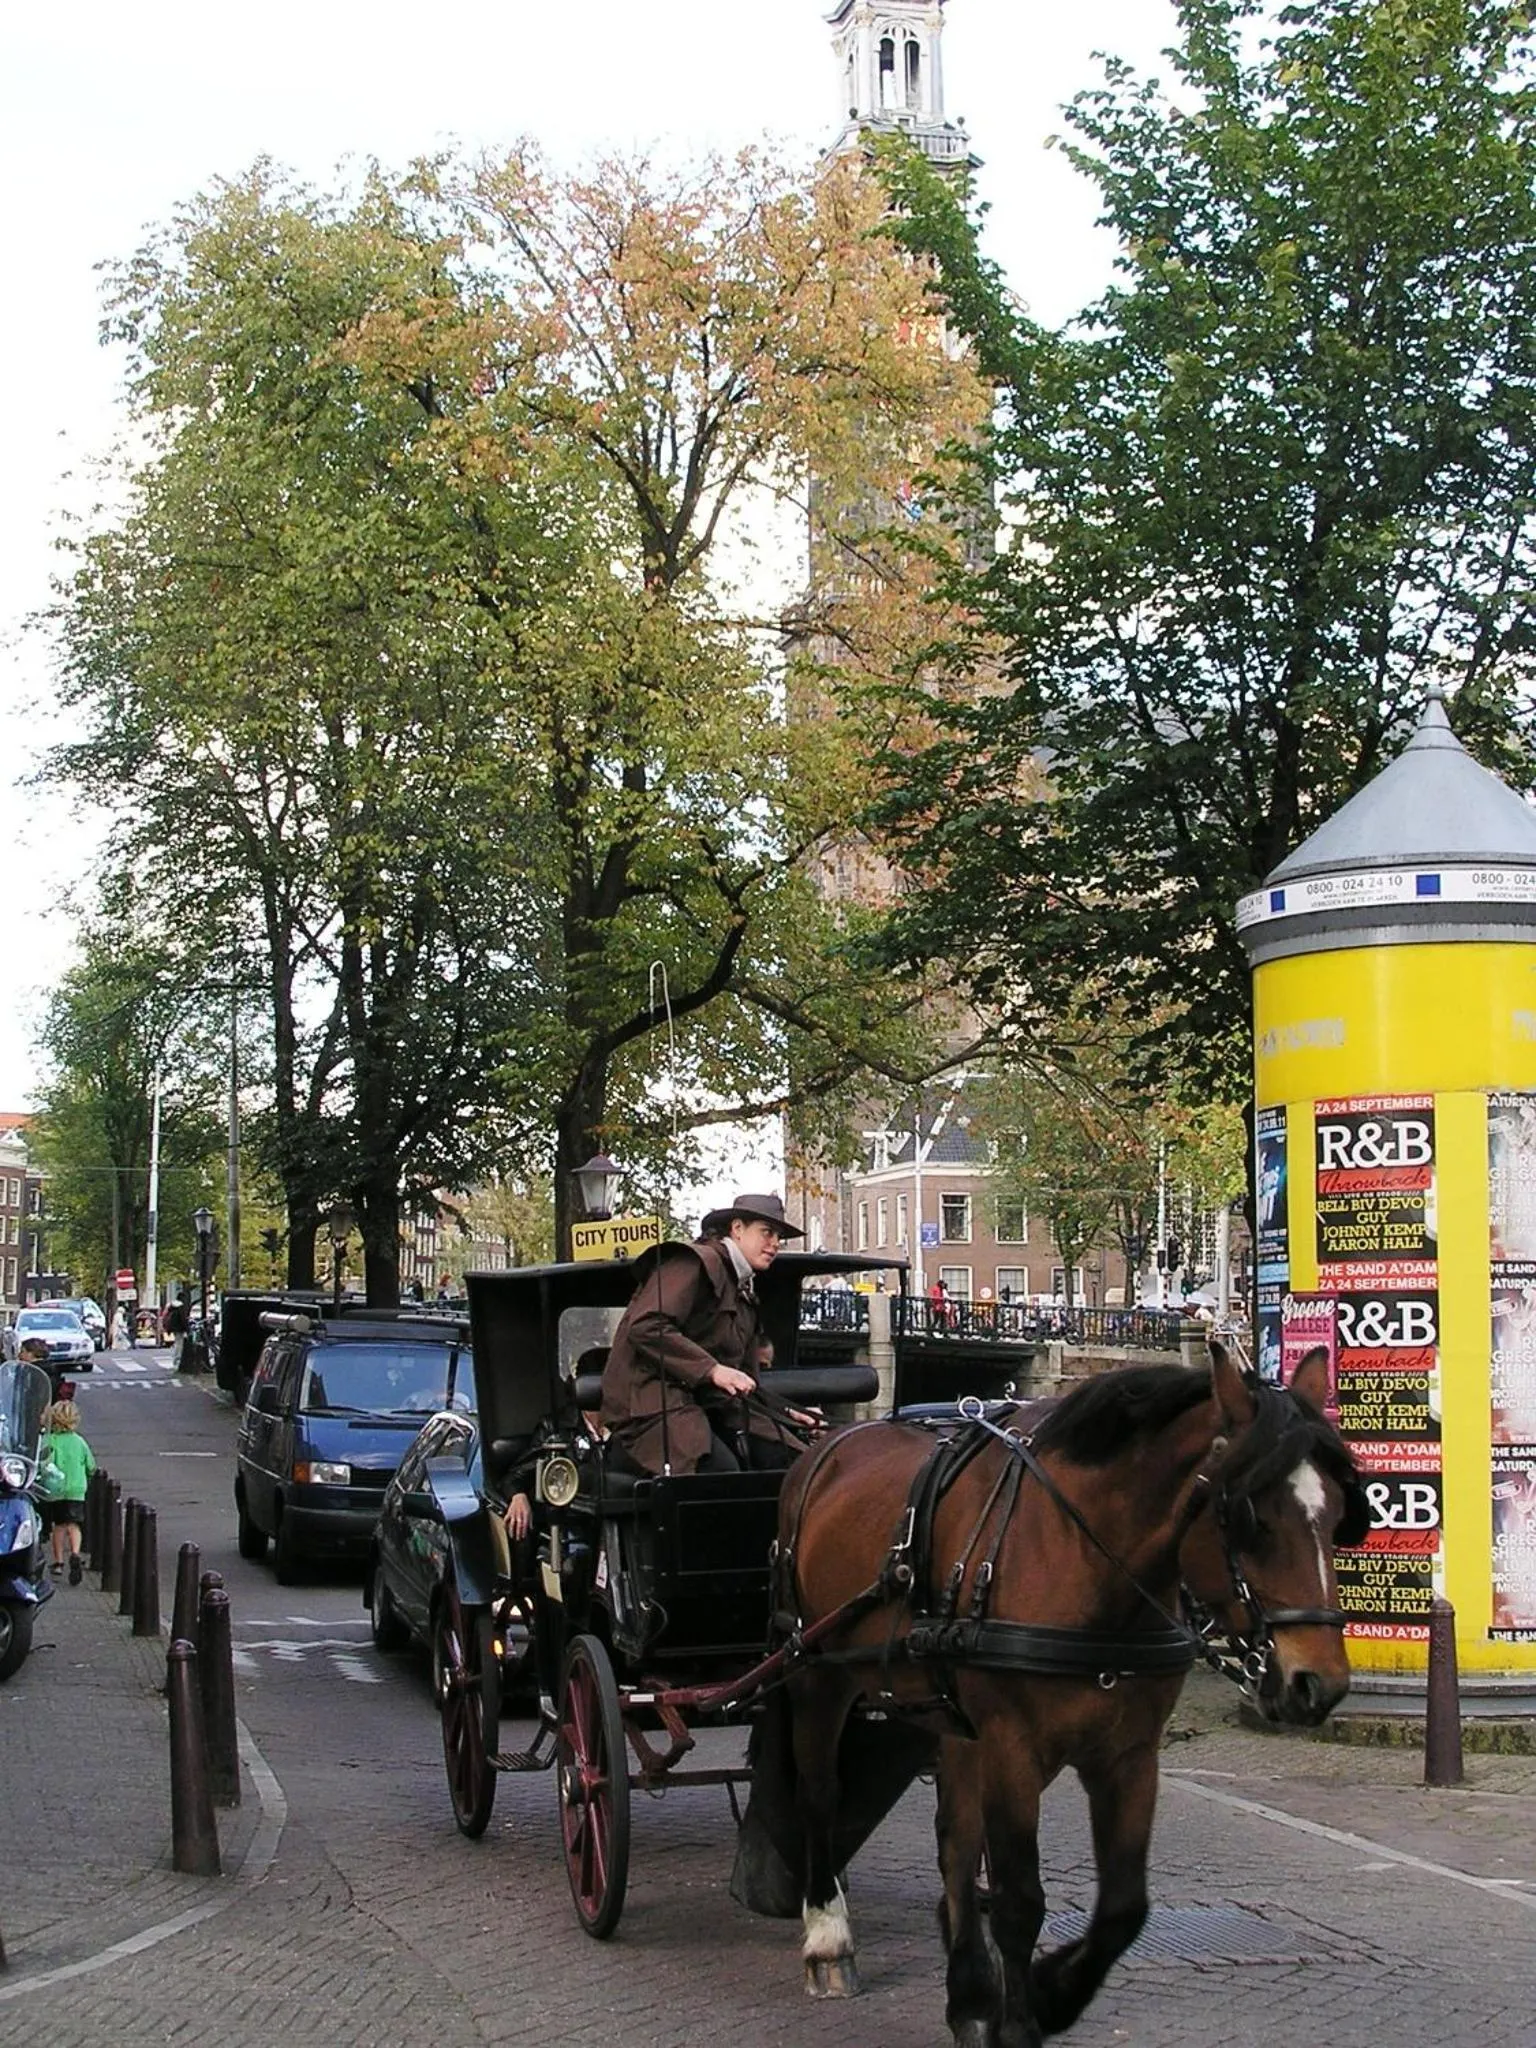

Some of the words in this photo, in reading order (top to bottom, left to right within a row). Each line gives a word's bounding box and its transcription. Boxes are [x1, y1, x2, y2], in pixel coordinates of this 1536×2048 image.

[1306, 881, 1333, 895] 0800
[1342, 878, 1365, 892] 024
[1388, 874, 1404, 887] 10
[1472, 872, 1504, 884] 0800
[1315, 1102, 1331, 1114] ZA
[1333, 1101, 1347, 1112] 24
[1349, 1096, 1433, 1112] SEPTEMBER
[1318, 1121, 1432, 1170] R&B
[1321, 1168, 1427, 1192] Throwback
[1317, 1199, 1349, 1213] BELL
[1351, 1198, 1377, 1211] BIV
[1356, 1211, 1390, 1224] GUY
[575, 1229, 607, 1247] CITY
[611, 1223, 660, 1243] TOURS
[1322, 1225, 1381, 1241] JOHNNY
[1383, 1223, 1427, 1236] KEMP
[1327, 1238, 1380, 1251] AARON
[1383, 1236, 1423, 1249] HALL
[1319, 1265, 1344, 1276] THE
[1346, 1263, 1386, 1275] SAND
[1389, 1262, 1437, 1274] A'DAM
[1320, 1279, 1335, 1290] ZA
[1337, 1279, 1352, 1290] 24
[1354, 1276, 1437, 1290] SEPTEMBER
[1282, 1293, 1335, 1324] Groove
[1338, 1301, 1436, 1348] R&B
[1355, 1378, 1379, 1390] BIV
[1360, 1391, 1393, 1403] GUY
[1387, 1405, 1431, 1417] KEMP
[1386, 1418, 1427, 1430] HALL
[1350, 1443, 1389, 1455] SAND
[1392, 1443, 1440, 1455] A'DAM
[1358, 1560, 1382, 1572] BIV
[1363, 1573, 1396, 1585] GUY
[1390, 1587, 1434, 1600] KEMP
[1389, 1600, 1430, 1613] HALL
[1353, 1624, 1393, 1637] SAND
